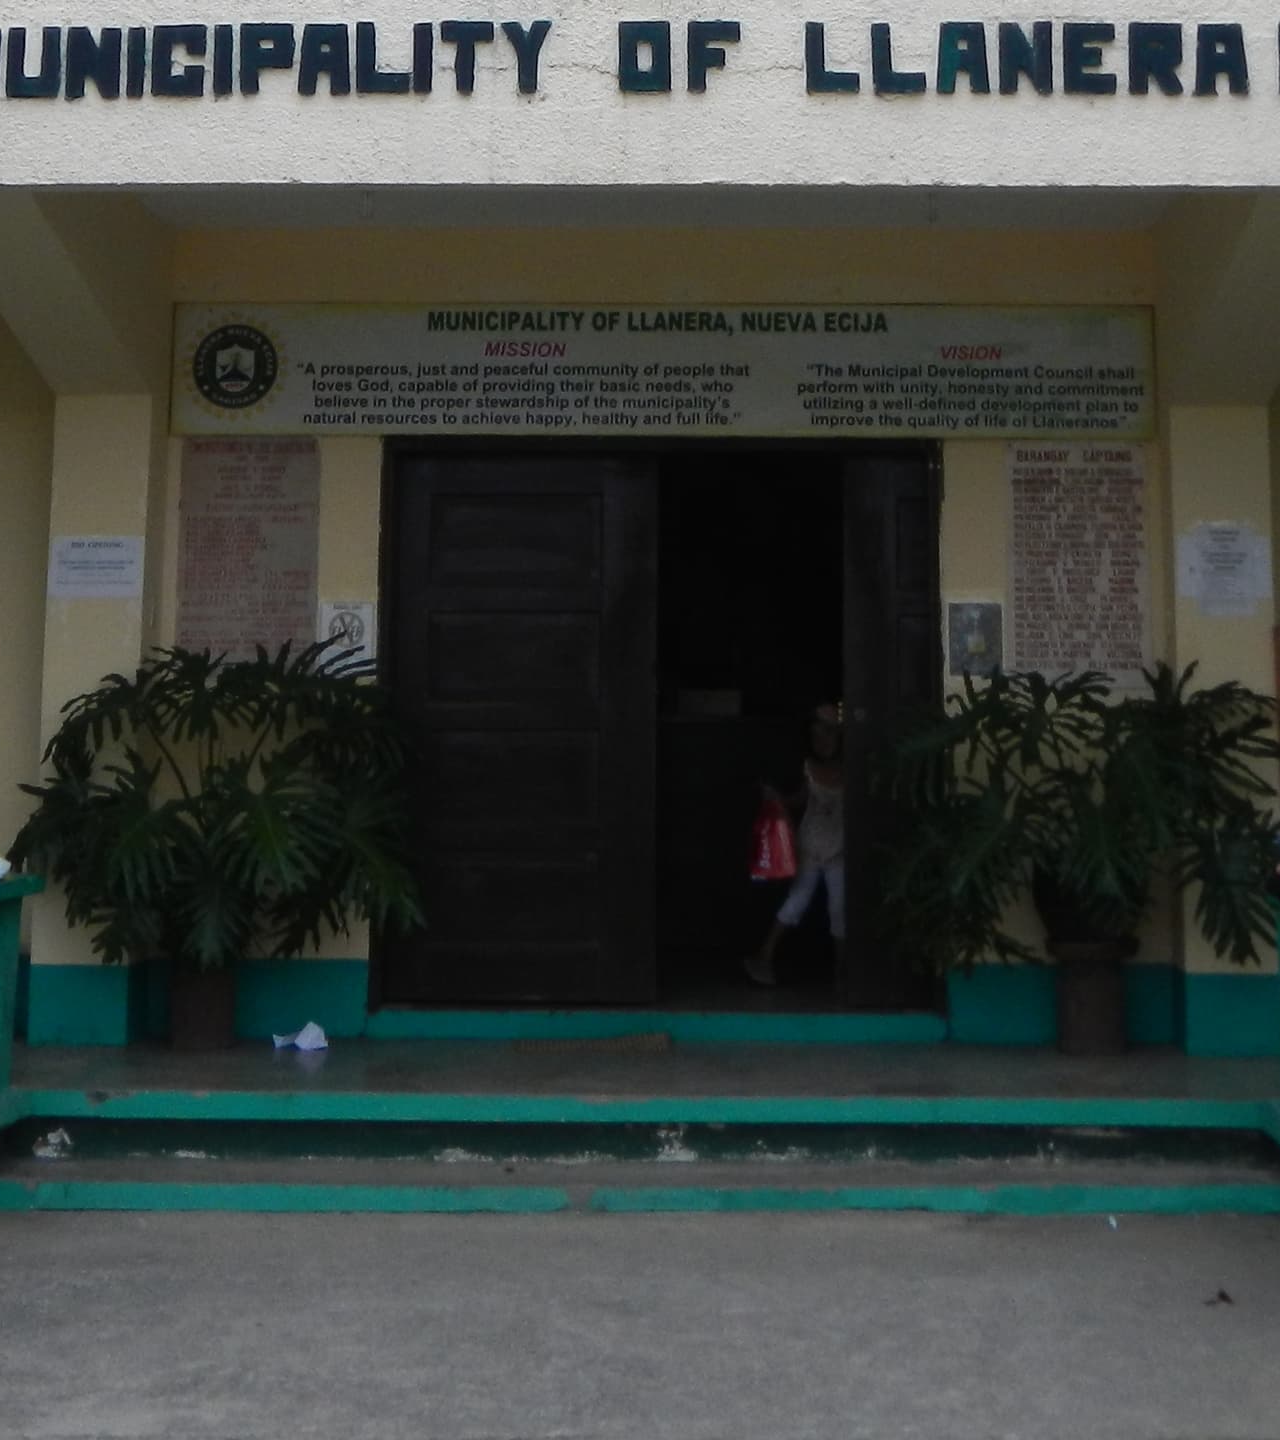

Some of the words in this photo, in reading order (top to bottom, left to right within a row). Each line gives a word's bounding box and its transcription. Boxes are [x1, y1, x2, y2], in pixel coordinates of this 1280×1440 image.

[617, 20, 741, 95] OF
[804, 21, 1251, 97] LLANERA
[427, 311, 585, 332] MUNICIPALITY
[592, 311, 620, 332] OF
[627, 311, 734, 335] LLANERA,
[741, 311, 816, 332] NUEVA
[824, 312, 888, 332] ECIJA
[484, 342, 566, 357] MISSION
[940, 346, 1003, 360] VISION
[320, 364, 412, 379] prosperous,
[417, 363, 446, 378] just
[450, 364, 479, 375] and
[484, 363, 548, 379] peaceful
[553, 364, 638, 378] community
[643, 364, 658, 375] of
[664, 364, 715, 378] people
[720, 364, 749, 375] that
[848, 364, 923, 380] Municipal
[927, 364, 1029, 380] Development
[1034, 365, 1094, 379] Council
[1098, 366, 1135, 379] shall
[312, 380, 352, 392] loves
[398, 380, 458, 395] capable
[462, 380, 479, 392] of
[482, 379, 555, 395] providing
[560, 380, 594, 392] their
[600, 380, 640, 392] basic
[701, 381, 734, 392] who
[797, 381, 858, 396] perform
[863, 382, 895, 395] with
[948, 382, 1009, 397] honesty
[1015, 382, 1043, 395] and
[1048, 383, 1145, 396] commitment
[314, 396, 368, 409] believe
[373, 396, 387, 409] in
[391, 396, 415, 409] the
[420, 398, 471, 411] proper
[476, 396, 569, 410] stewardship
[574, 396, 590, 409] of
[594, 396, 618, 409] the
[622, 396, 730, 411] municipality's
[803, 397, 864, 413] utilizing
[869, 400, 878, 410] a
[882, 397, 976, 411] well-defined
[981, 399, 1081, 413] development
[1086, 399, 1119, 415] plan
[1123, 400, 1139, 413] to
[303, 412, 355, 425] natural
[361, 412, 437, 425] resources
[442, 412, 457, 425] to
[461, 412, 521, 425] achieve
[582, 412, 638, 427] healthy
[643, 412, 672, 425] and
[676, 412, 701, 425] full
[811, 413, 873, 428] improve
[878, 414, 903, 427] the
[907, 414, 959, 430] quality
[964, 415, 980, 428] of
[984, 415, 1007, 427] life
